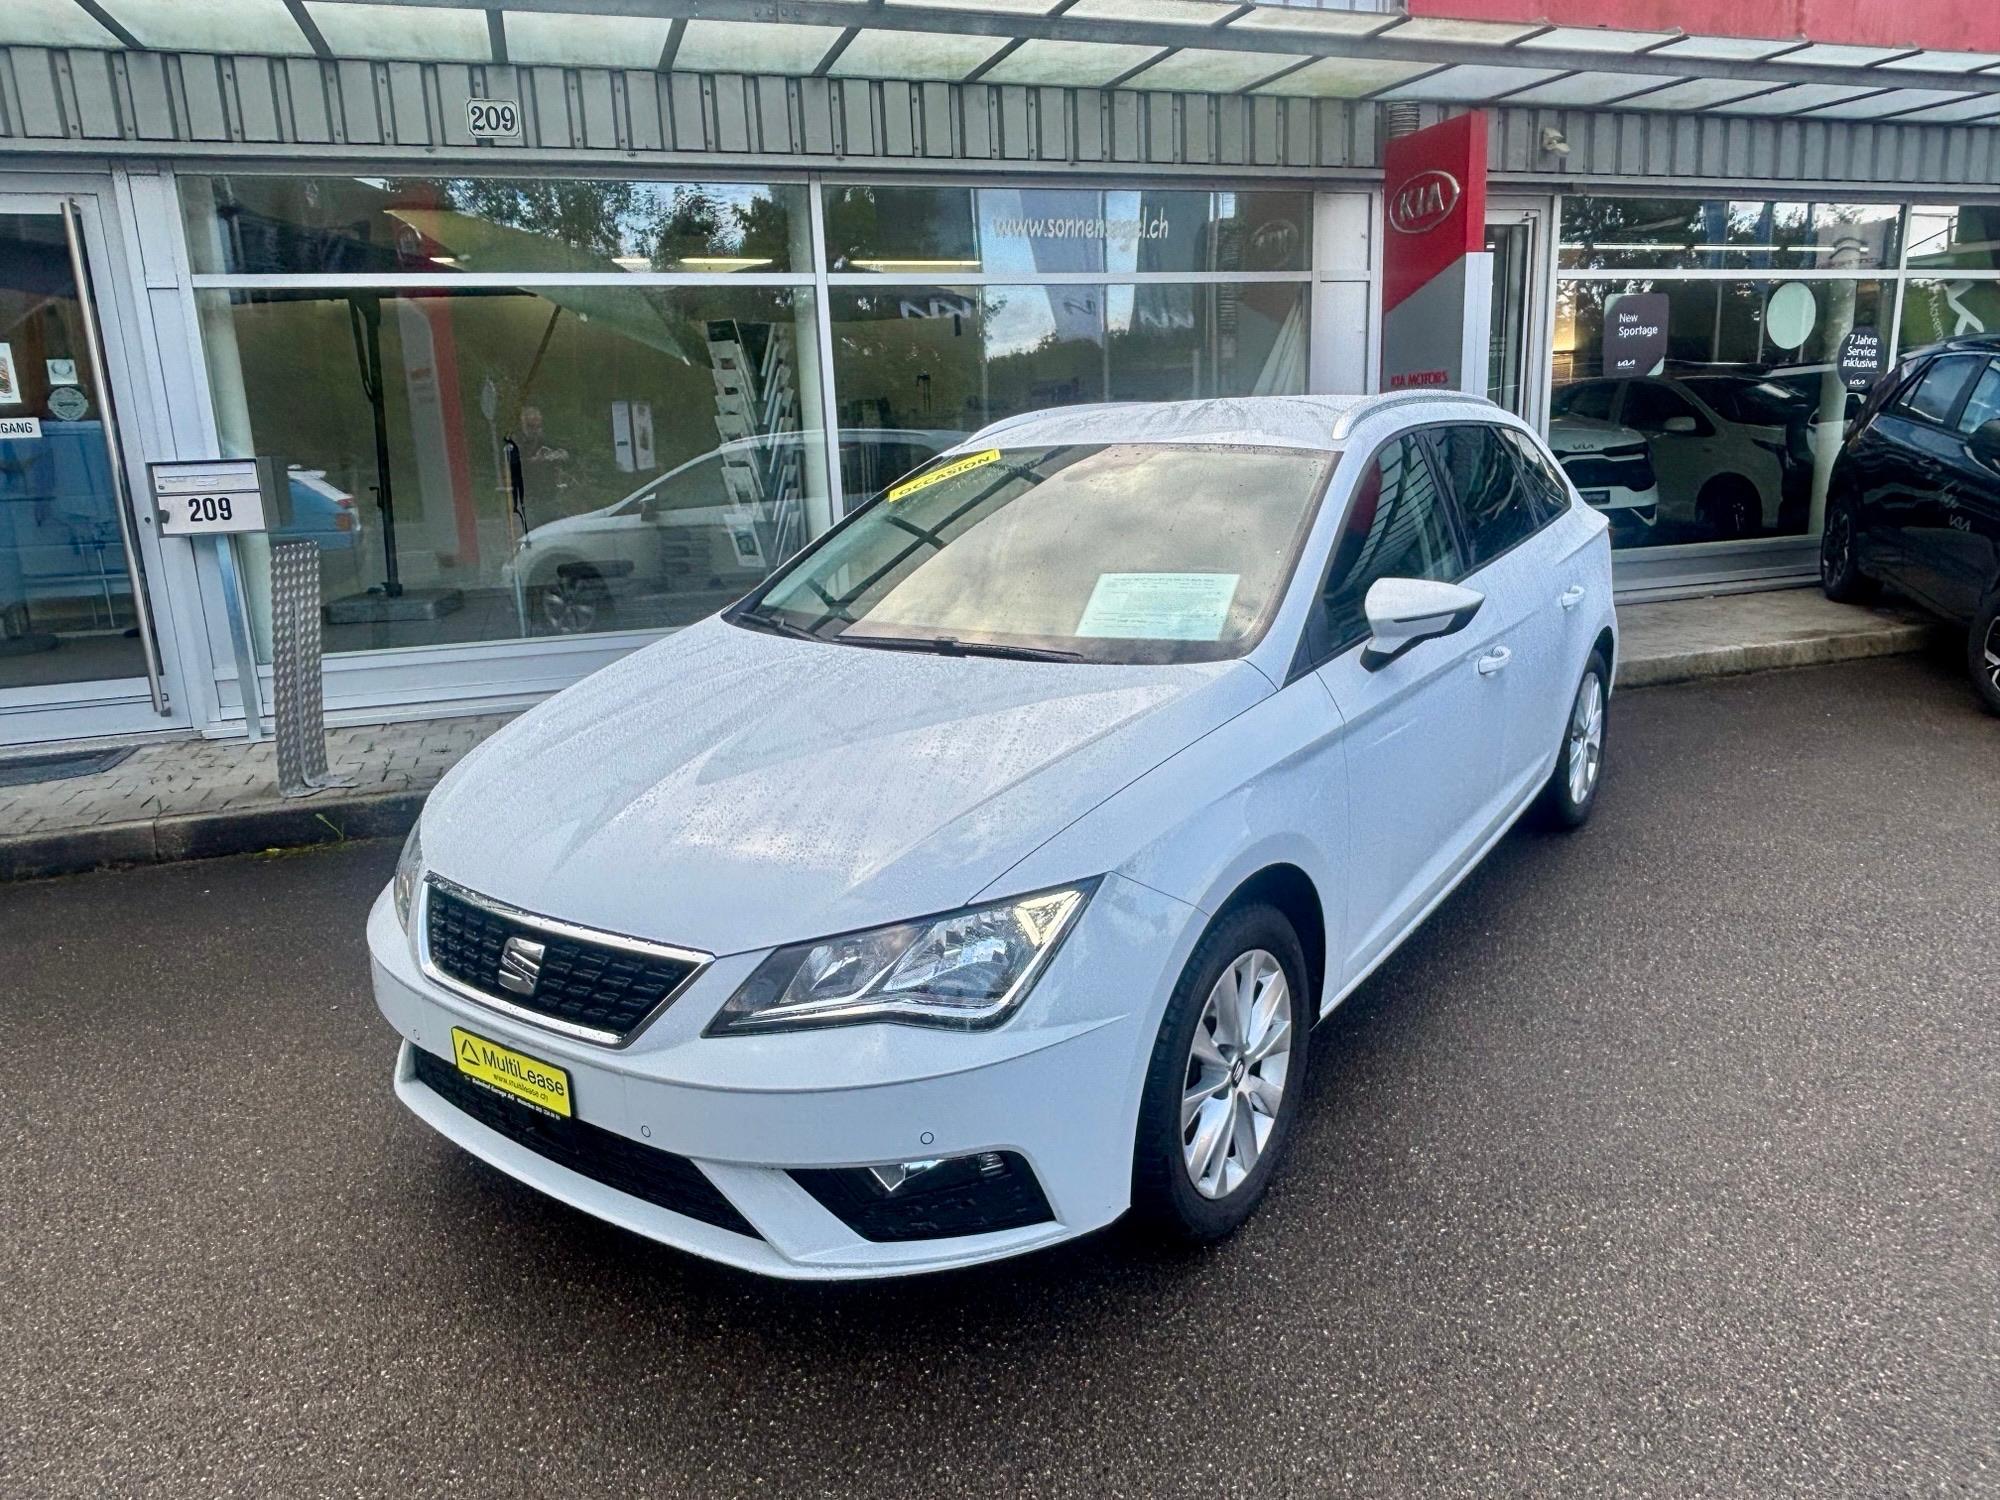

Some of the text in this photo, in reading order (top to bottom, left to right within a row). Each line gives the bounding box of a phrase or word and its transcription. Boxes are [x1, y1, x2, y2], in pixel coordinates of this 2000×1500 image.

[471, 106, 516, 131] 209
[1400, 182, 1445, 222] KIA
[1619, 313, 1639, 323] New
[1618, 325, 1659, 338] Sportage
[1849, 334, 1878, 345] 7 Jahre
[1847, 346, 1877, 357] Service
[1842, 357, 1878, 368] inklusive
[1391, 370, 1449, 386] KIA MOTORS
[0, 421, 33, 434] GANG
[898, 455, 991, 495] OCCASION
[188, 497, 233, 522] 209
[482, 1046, 565, 1096] MultiLease
